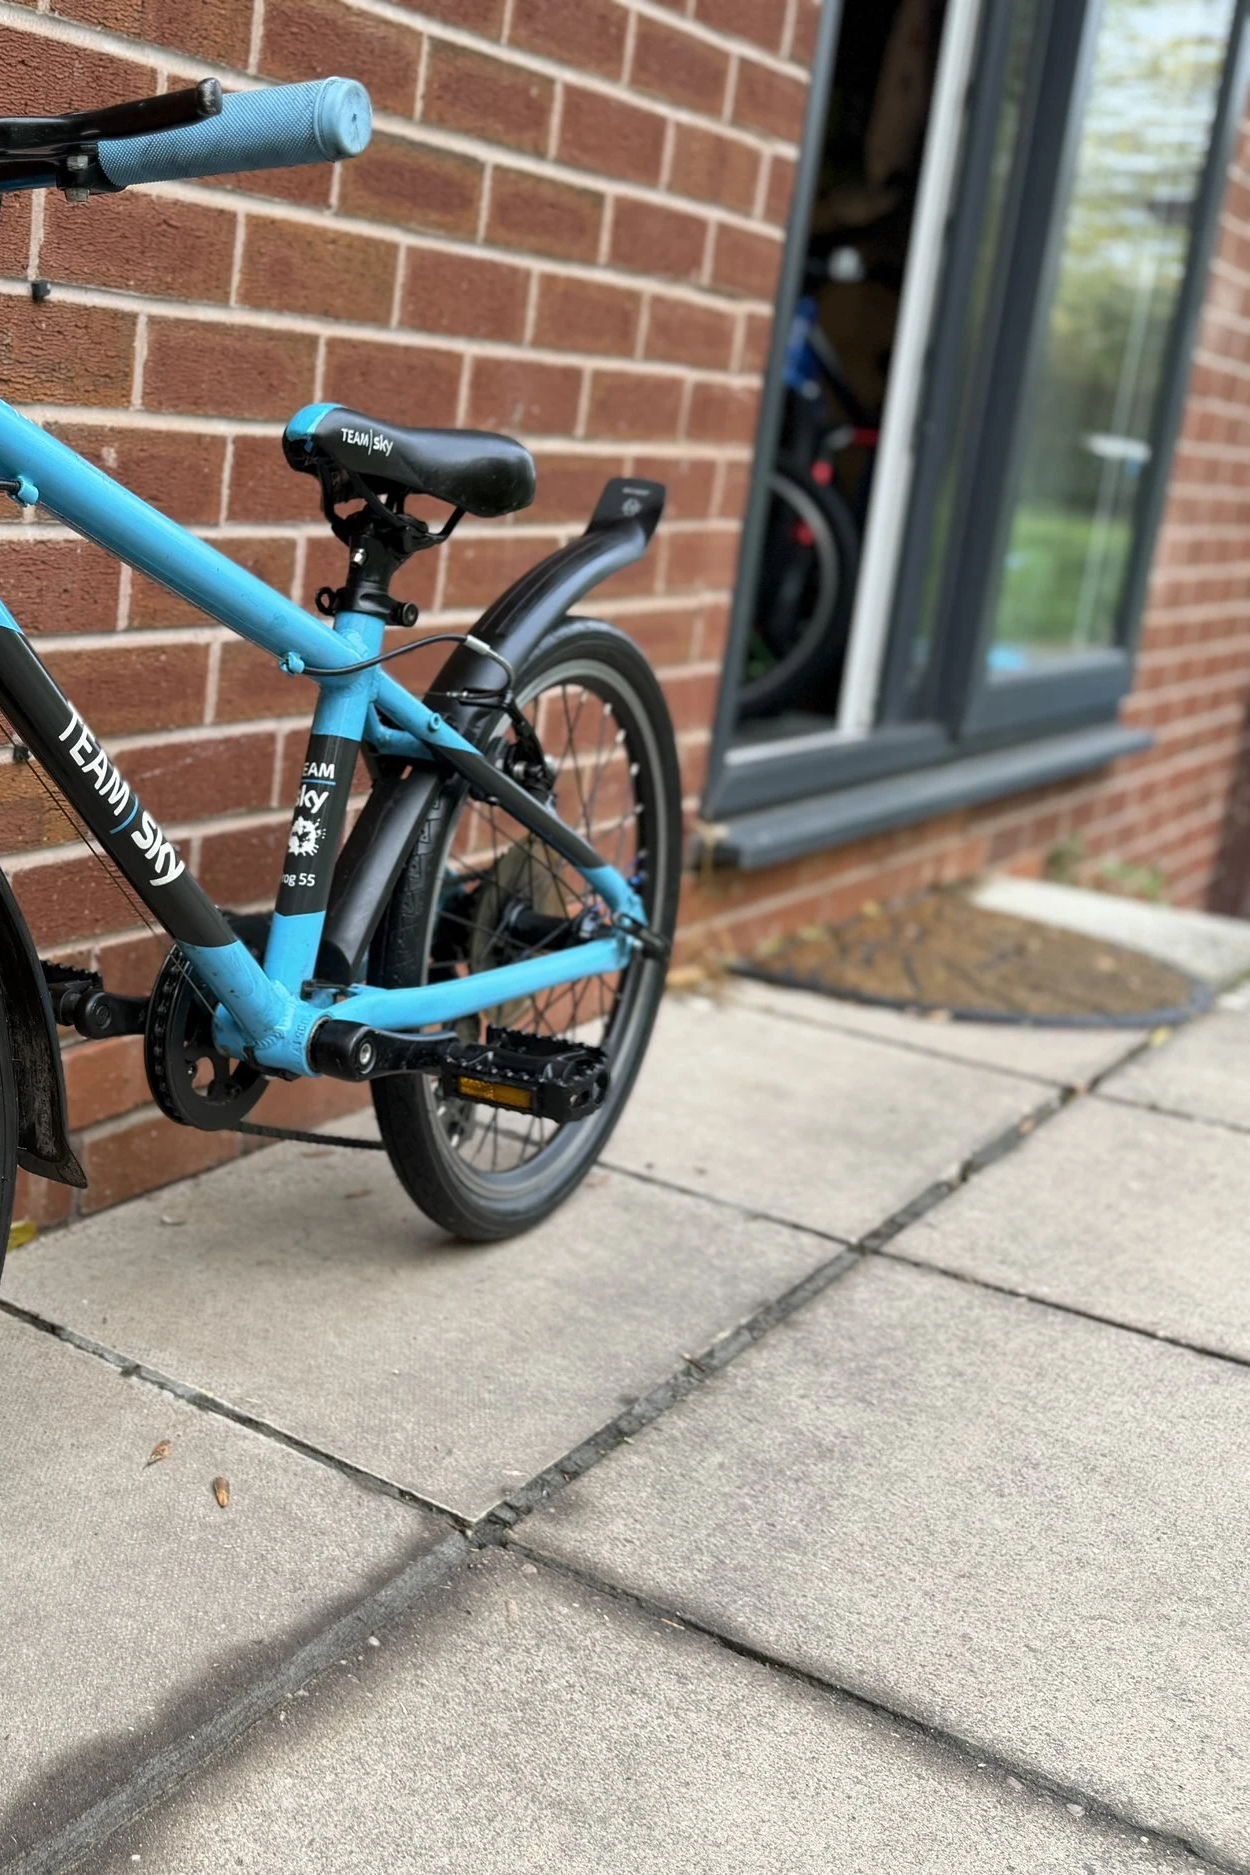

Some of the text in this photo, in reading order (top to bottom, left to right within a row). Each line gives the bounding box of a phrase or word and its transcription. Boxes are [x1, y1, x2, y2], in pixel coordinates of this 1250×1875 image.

[341, 428, 394, 456] TEAM sky
[59, 701, 130, 816] TEAM
[302, 762, 335, 779] EAM
[297, 784, 329, 814] ky
[299, 873, 316, 887] 55
